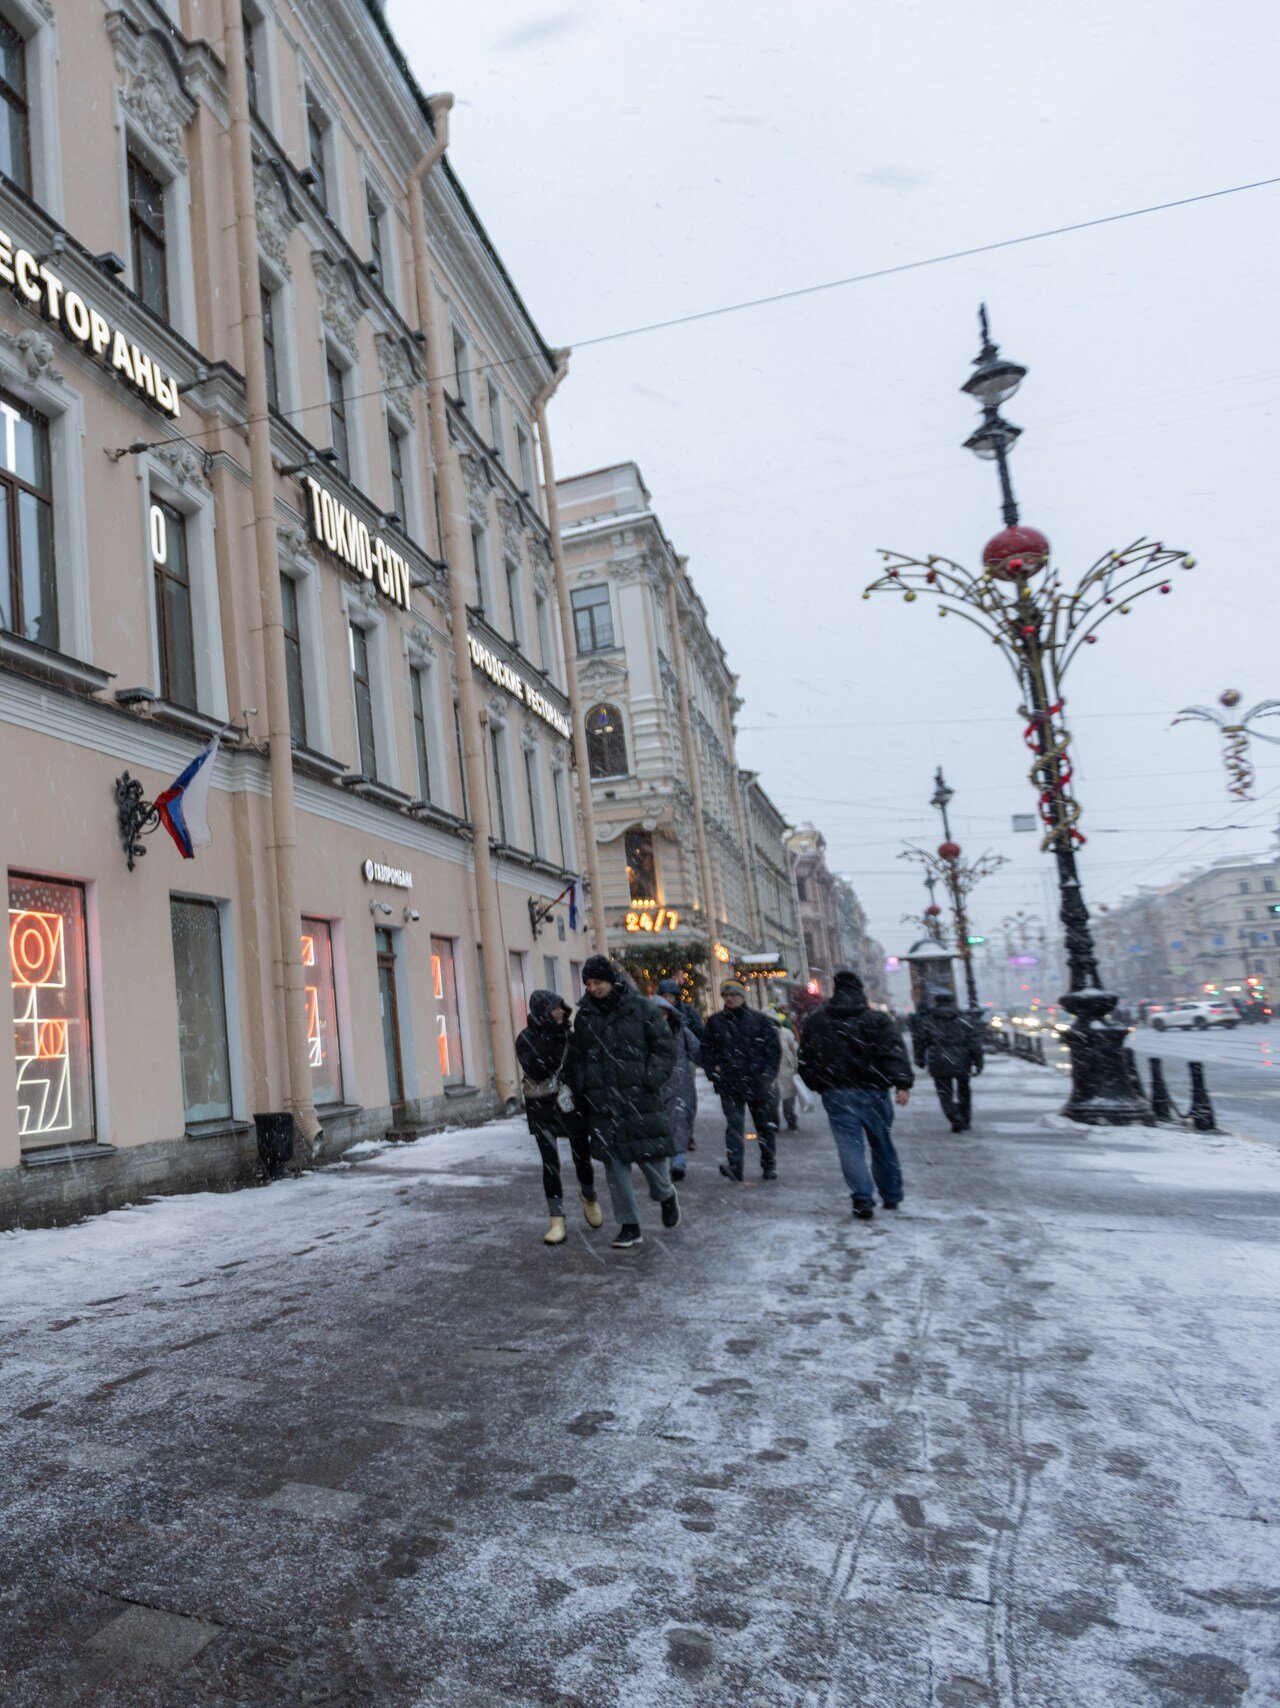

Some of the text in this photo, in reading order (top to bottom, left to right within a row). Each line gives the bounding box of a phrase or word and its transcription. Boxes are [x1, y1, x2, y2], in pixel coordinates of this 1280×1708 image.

[306, 476, 411, 611] ТОКИО-CITY
[467, 634, 524, 700] ОРОДСКИЕ
[625, 908, 679, 933] 24/7
